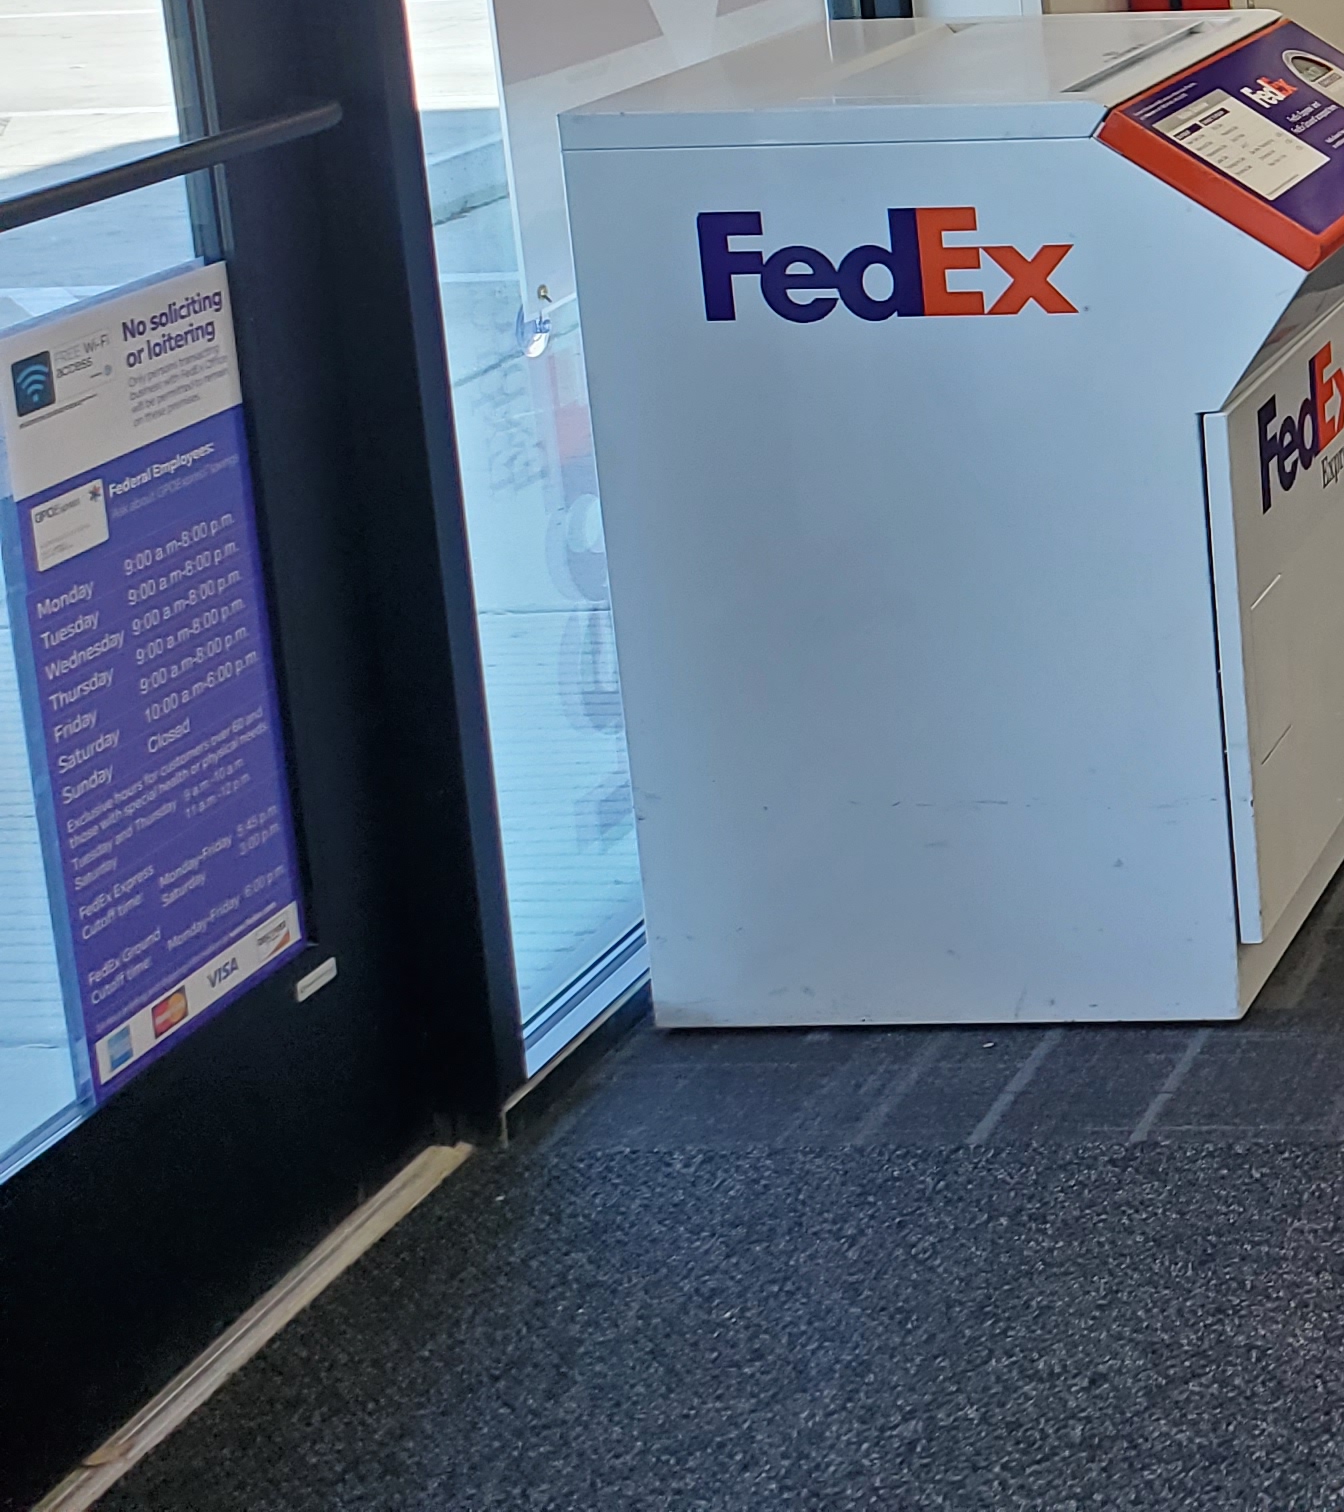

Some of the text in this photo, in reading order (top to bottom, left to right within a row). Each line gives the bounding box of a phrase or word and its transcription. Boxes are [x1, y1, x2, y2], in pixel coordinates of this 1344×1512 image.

[1240, 76, 1298, 109] FedEx
[696, 206, 1079, 323] FedEx
[122, 290, 223, 341] No soliciting
[126, 320, 215, 368] or loitering
[56, 356, 93, 378] access
[109, 468, 151, 498] Federal
[124, 549, 152, 576] 9:00
[37, 580, 94, 619] Monday
[128, 579, 156, 605] 9:00
[40, 610, 99, 649] Tuesday
[132, 608, 160, 635] 9:00
[45, 629, 125, 680] Wednesday
[136, 638, 164, 665] 9:00
[49, 667, 114, 711] Thursday
[140, 668, 167, 694] 9:00
[53, 708, 97, 743] Friday
[145, 692, 178, 723] 10:00
[58, 729, 120, 774] Saturday
[147, 717, 190, 754] Closed
[62, 764, 113, 805] Sunday
[67, 798, 114, 833] Exclusive
[79, 864, 155, 920] FedEx Express
[88, 926, 162, 986] FedEx Ground
[207, 956, 240, 988] VISA
